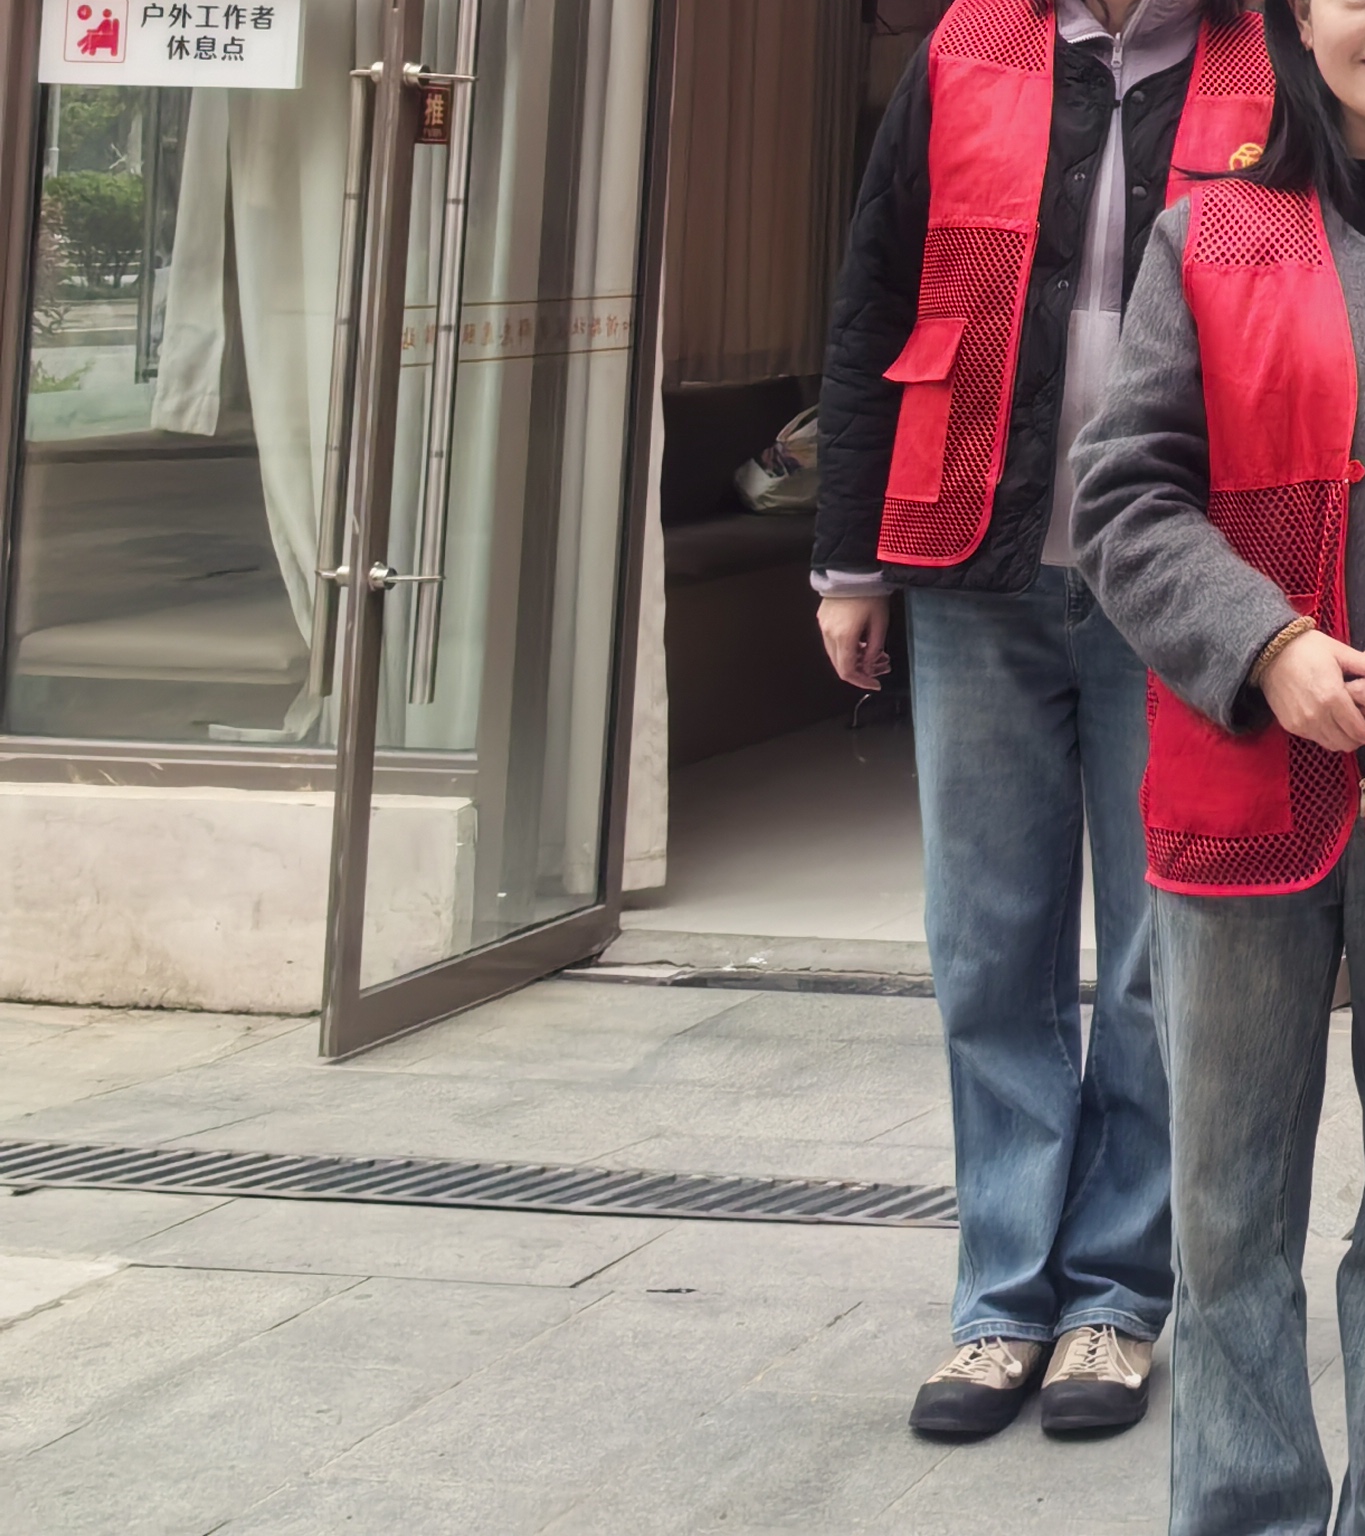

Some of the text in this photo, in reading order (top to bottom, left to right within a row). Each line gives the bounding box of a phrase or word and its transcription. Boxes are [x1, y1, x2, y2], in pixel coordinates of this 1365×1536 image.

[140, 2, 275, 31] 户外工作者
[167, 35, 246, 62] 休息点
[424, 92, 445, 126] 推
